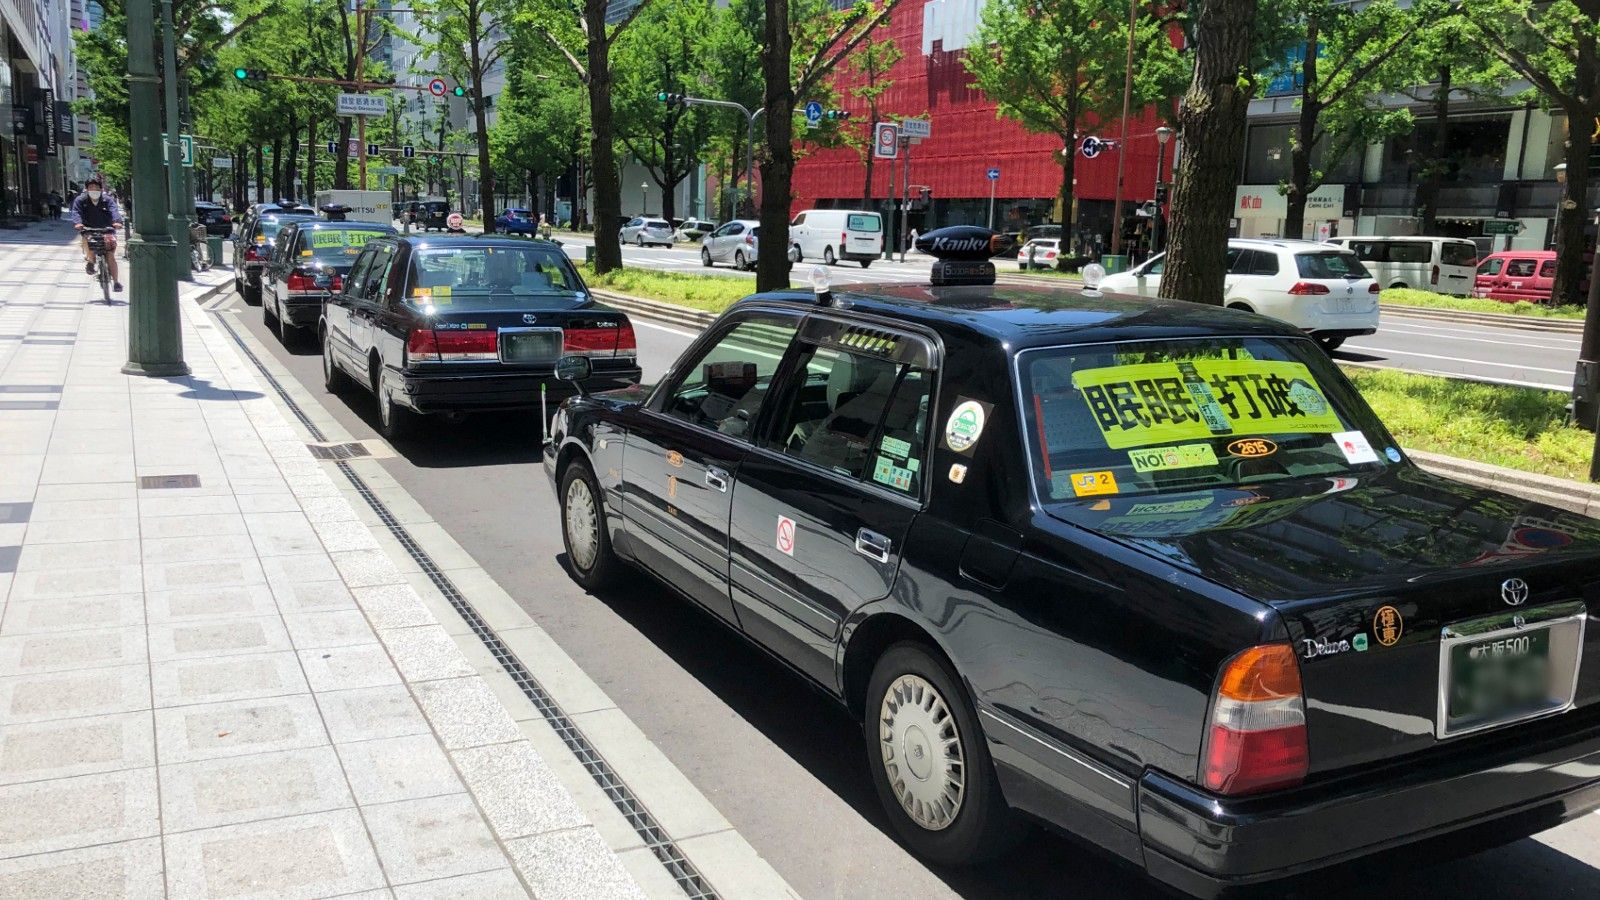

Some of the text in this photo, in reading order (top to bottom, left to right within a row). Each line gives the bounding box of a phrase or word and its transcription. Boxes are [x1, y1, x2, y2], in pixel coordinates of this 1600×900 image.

[60, 114, 72, 133] NIKE
[1240, 195, 1263, 209] 献血
[931, 236, 989, 252] Kanky
[1083, 373, 1306, 432] 眠眠打破
[1237, 441, 1268, 455] 2615
[1077, 473, 1110, 487] JR 2
[1302, 636, 1351, 659] Deluxe
